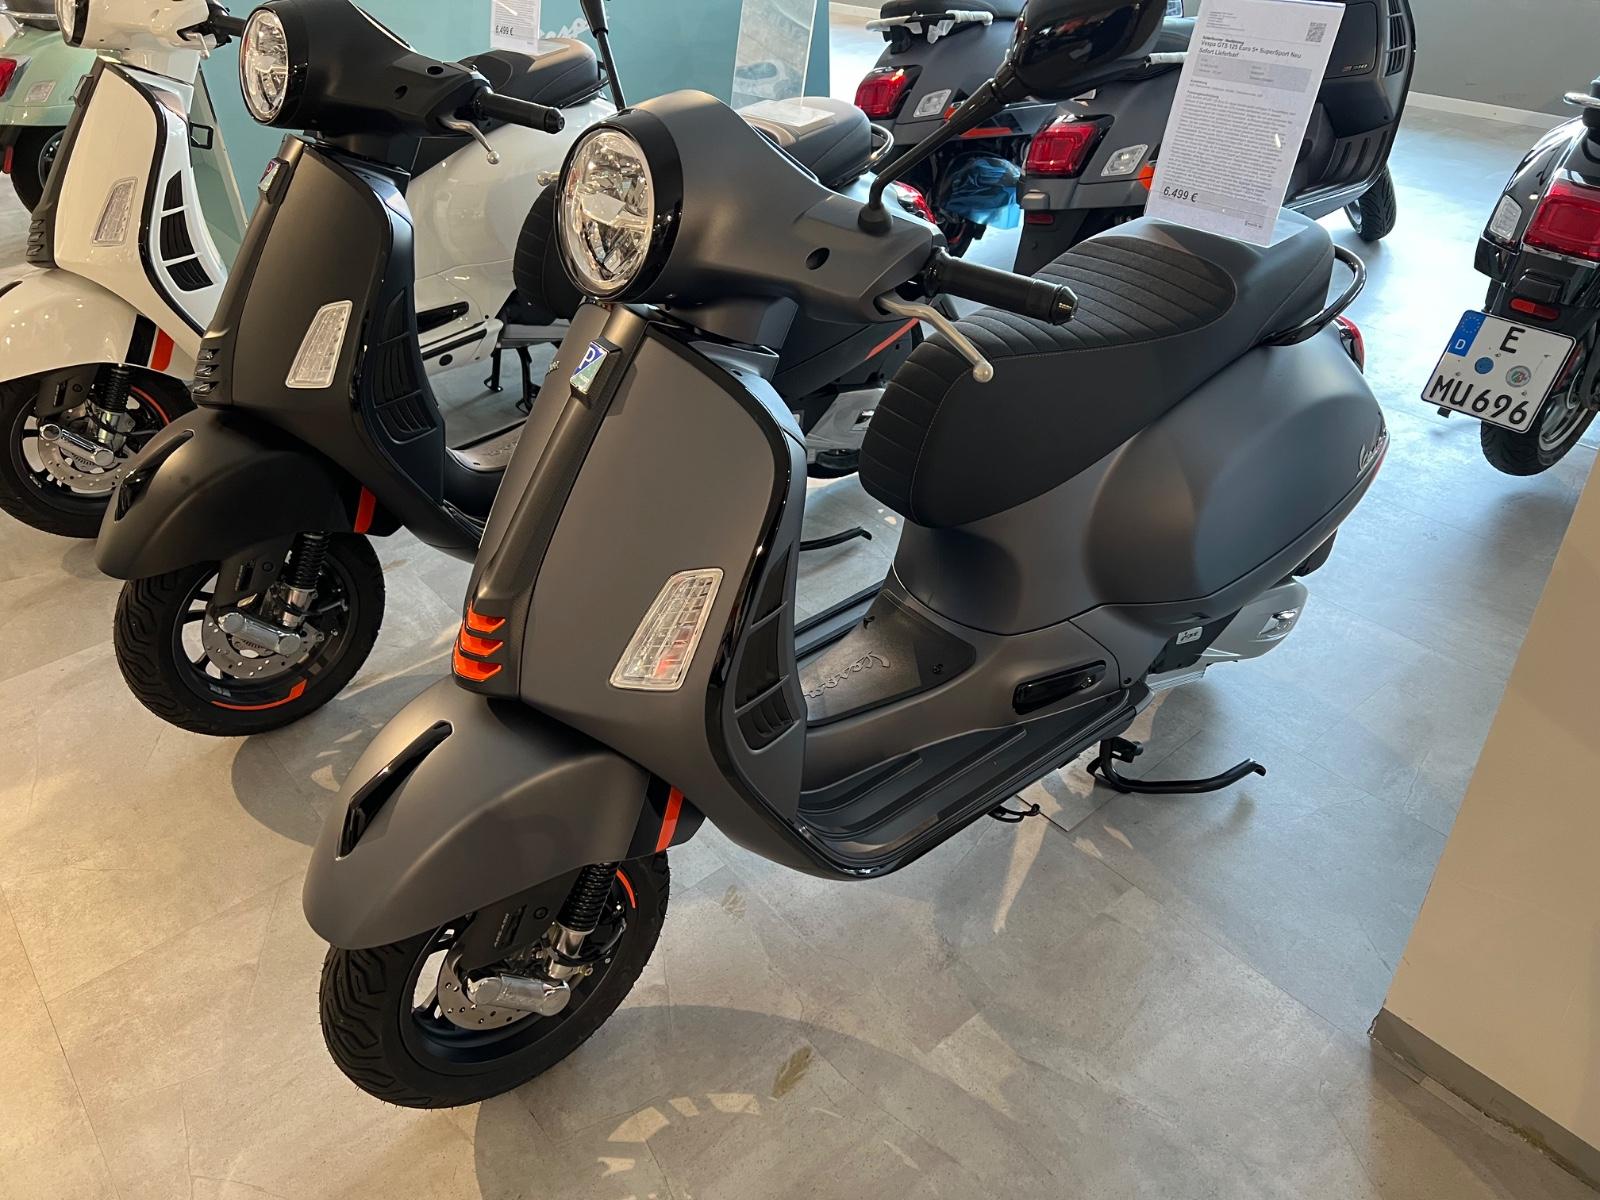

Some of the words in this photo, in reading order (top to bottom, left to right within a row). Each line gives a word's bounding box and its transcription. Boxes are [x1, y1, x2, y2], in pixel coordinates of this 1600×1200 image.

[1200, 47, 1214, 56] Sofort
[1201, 40, 1216, 48] Vespa
[1217, 41, 1228, 49] GTS
[1239, 44, 1251, 52] Euro
[1163, 186, 1189, 200] 6.499
[1191, 192, 1198, 202] €
[1455, 339, 1466, 350] D
[1500, 326, 1526, 354] E
[1429, 375, 1474, 407] MU
[1471, 389, 1529, 425] 696
[804, 651, 890, 698] Vespa
